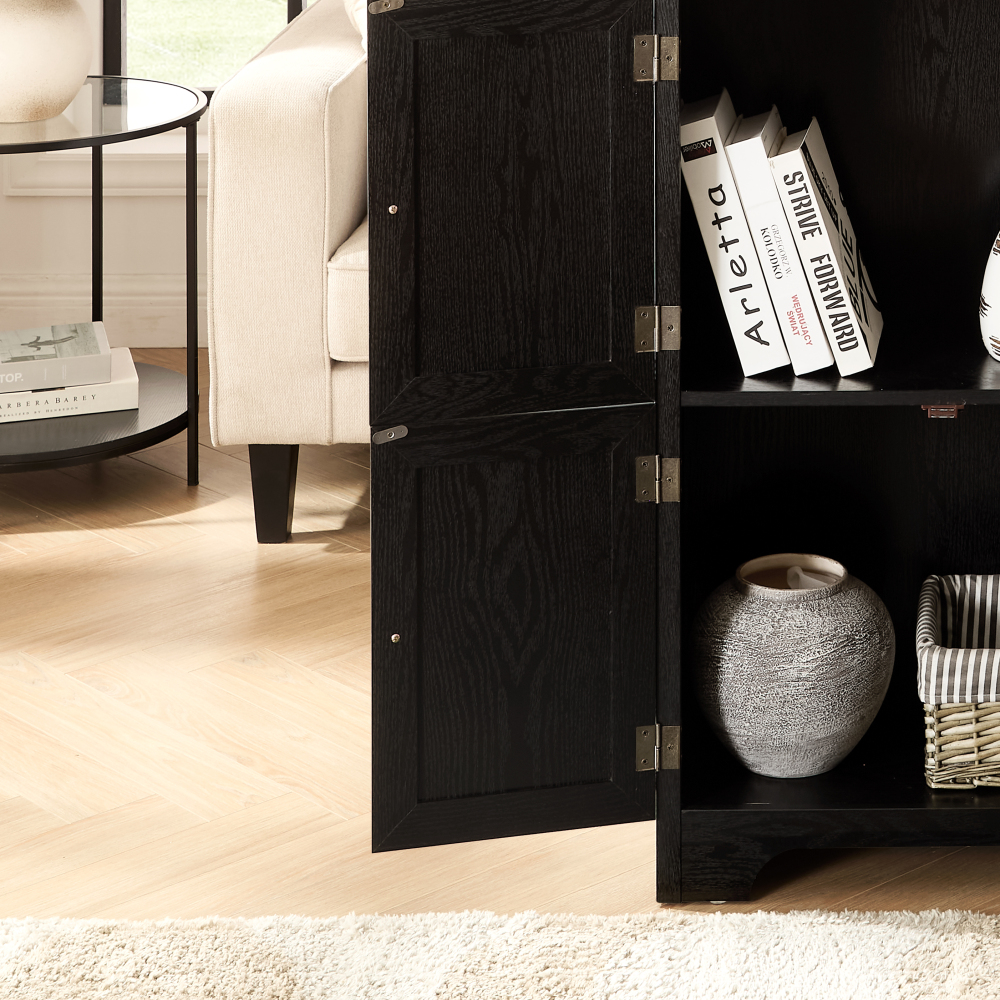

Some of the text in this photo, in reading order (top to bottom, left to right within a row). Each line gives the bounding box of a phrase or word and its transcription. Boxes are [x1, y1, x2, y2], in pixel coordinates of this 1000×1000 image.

[708, 183, 770, 346] Arletta
[771, 224, 790, 266] GRZEGORZ
[783, 170, 823, 241] STRIVE
[810, 253, 859, 352] FORWARD
[55, 394, 96, 404] BAREY
